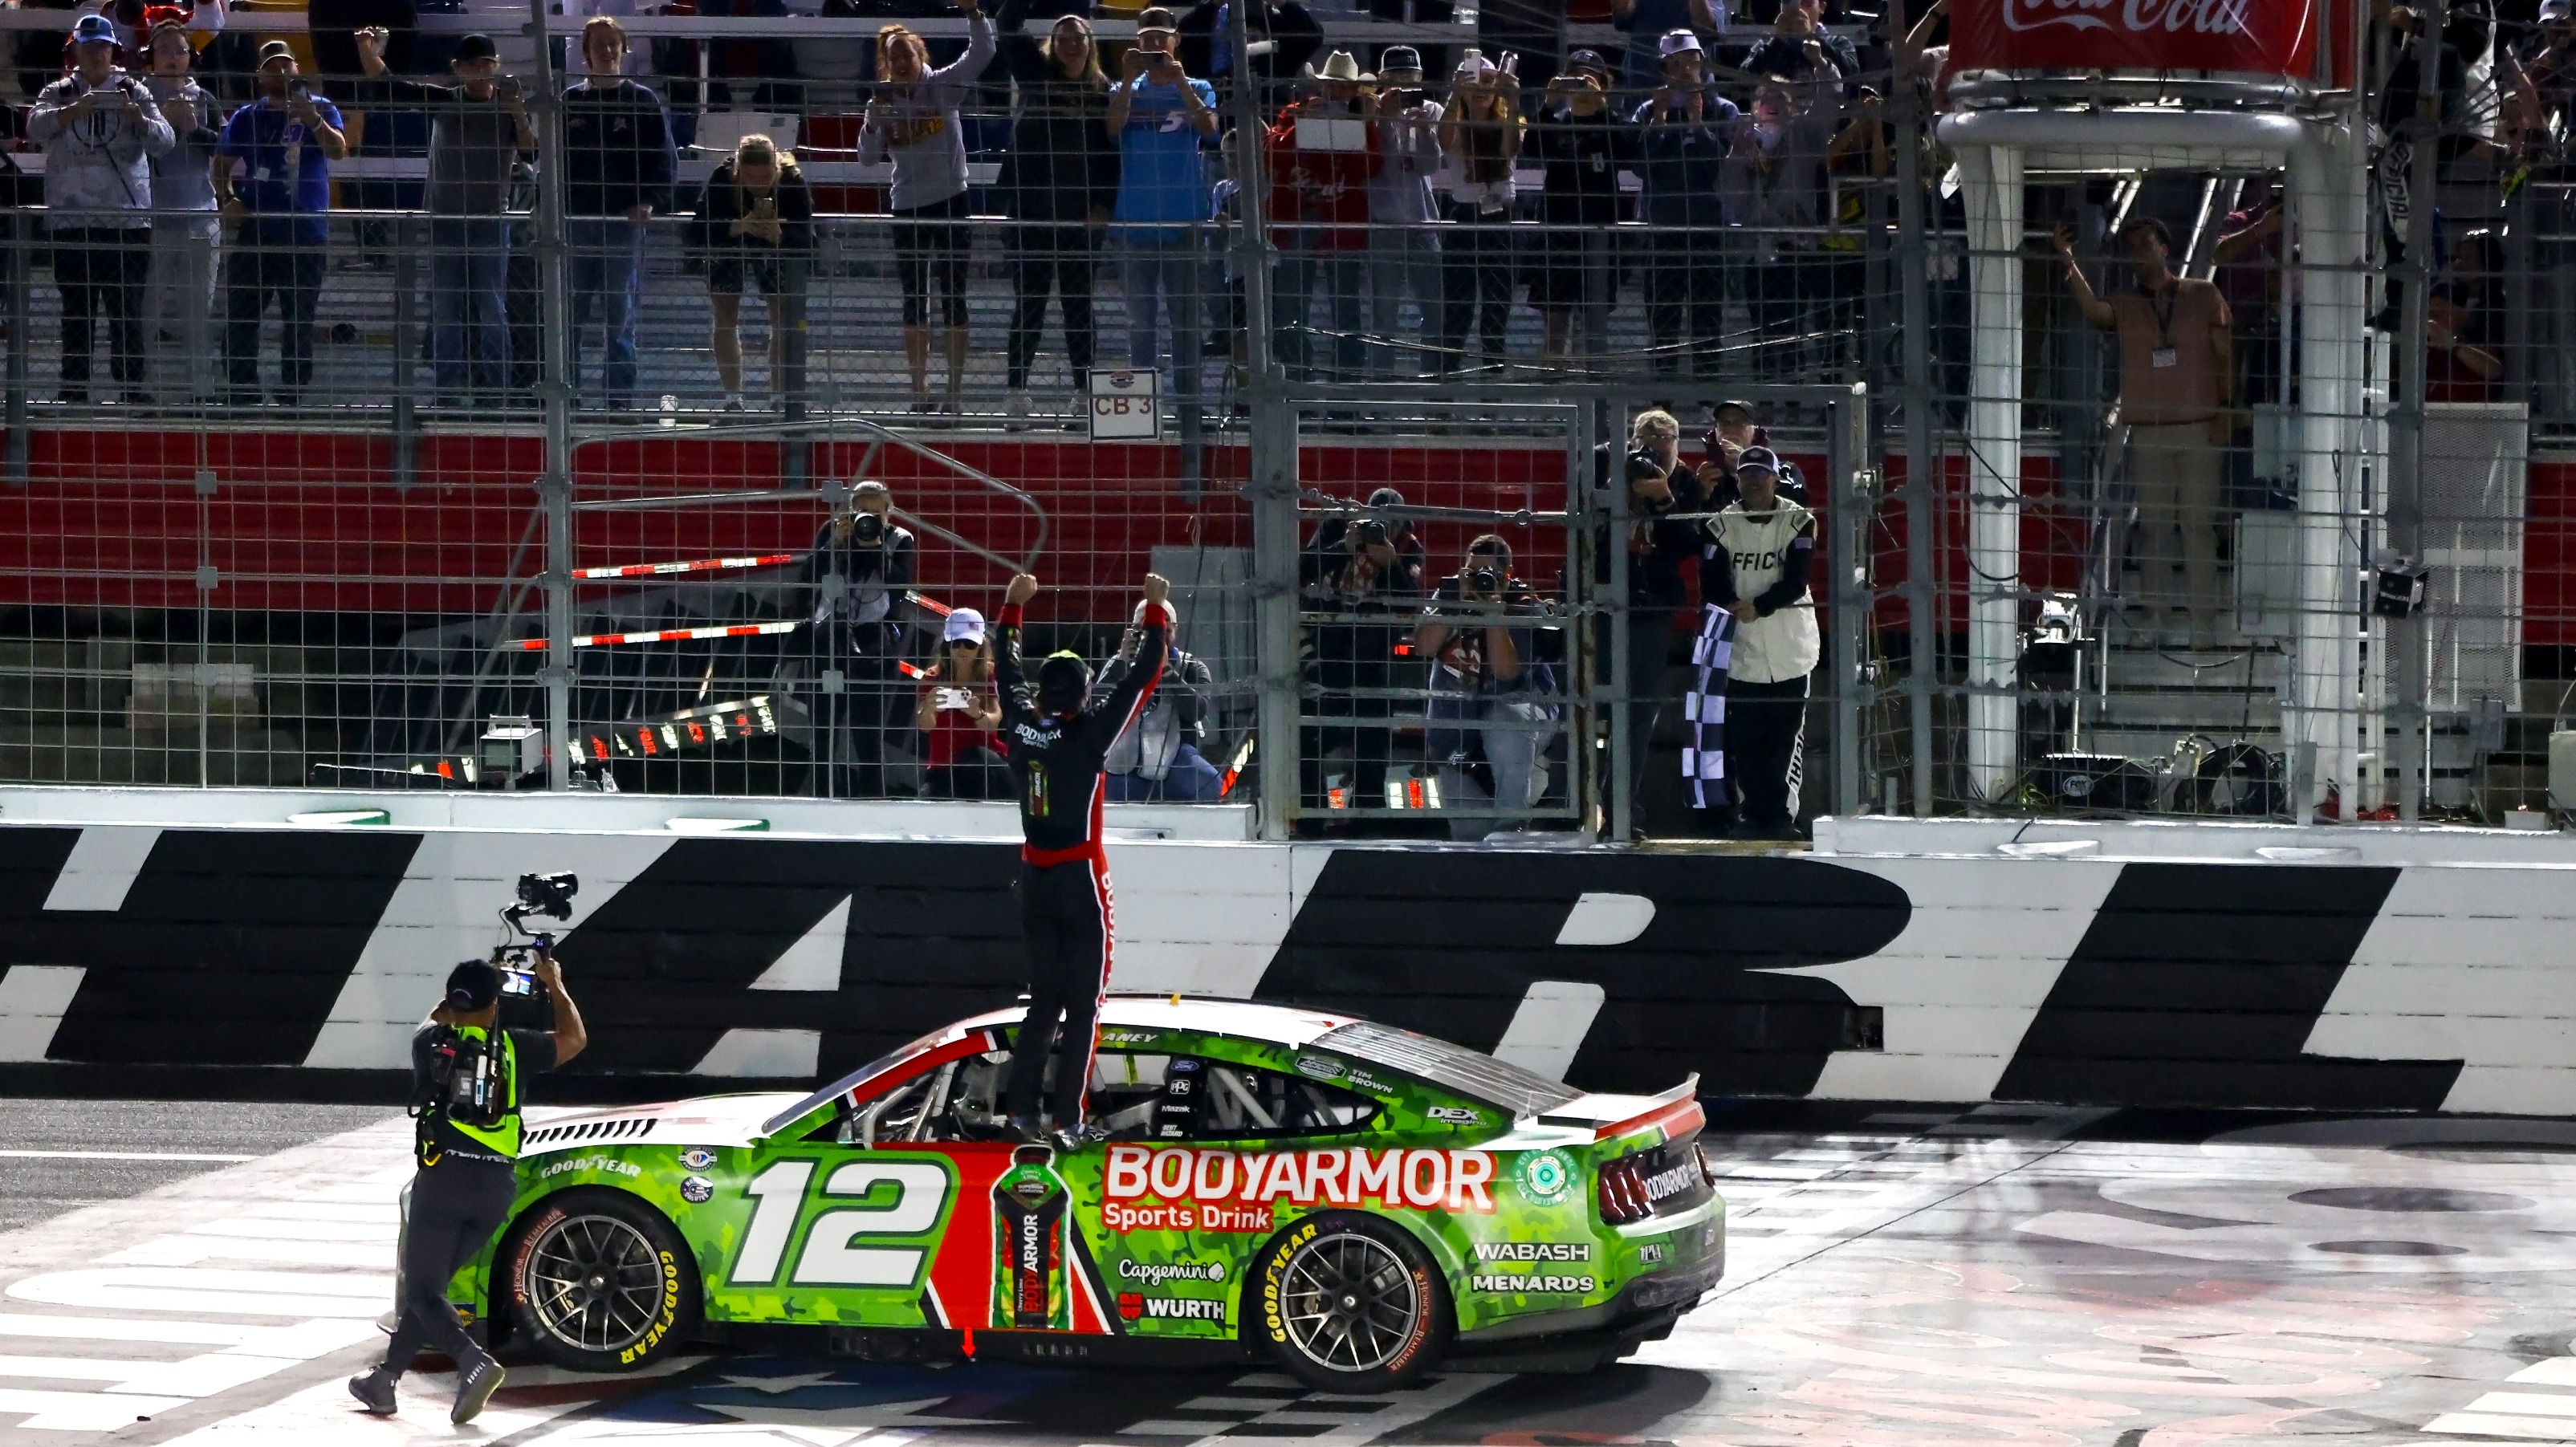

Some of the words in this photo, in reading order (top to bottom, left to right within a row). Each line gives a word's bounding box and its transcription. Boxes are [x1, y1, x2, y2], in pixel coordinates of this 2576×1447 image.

[1095, 395, 1130, 416] CB
[1139, 395, 1152, 415] 3
[1732, 551, 1784, 571] FFIC
[1101, 1032, 1158, 1043] ANEY
[1174, 1062, 1194, 1071] Ford
[1352, 1069, 1373, 1080] TIM
[1171, 1081, 1190, 1093] PPG
[1347, 1075, 1394, 1094] BROWN
[1162, 1105, 1190, 1113] Mazak
[1426, 1106, 1480, 1121] DEX
[540, 1154, 642, 1179] GOODYEAR
[1107, 1146, 1493, 1209] BODYARMOR
[728, 1160, 949, 1286] 12
[1105, 1204, 1194, 1231] Sports
[1203, 1205, 1269, 1230] Drink
[514, 1258, 525, 1292] HONOR
[523, 1209, 563, 1247] REMEMBER
[1473, 1244, 1589, 1261] WABASH
[1118, 1258, 1209, 1286] Capgemini
[1472, 1274, 1595, 1291] MENARDS
[1264, 1223, 1318, 1343] GOODYEAR
[620, 1250, 679, 1364] GOODYEAR
[1418, 1282, 1430, 1317] HONOR
[1390, 1330, 1426, 1371] REMEMBER
